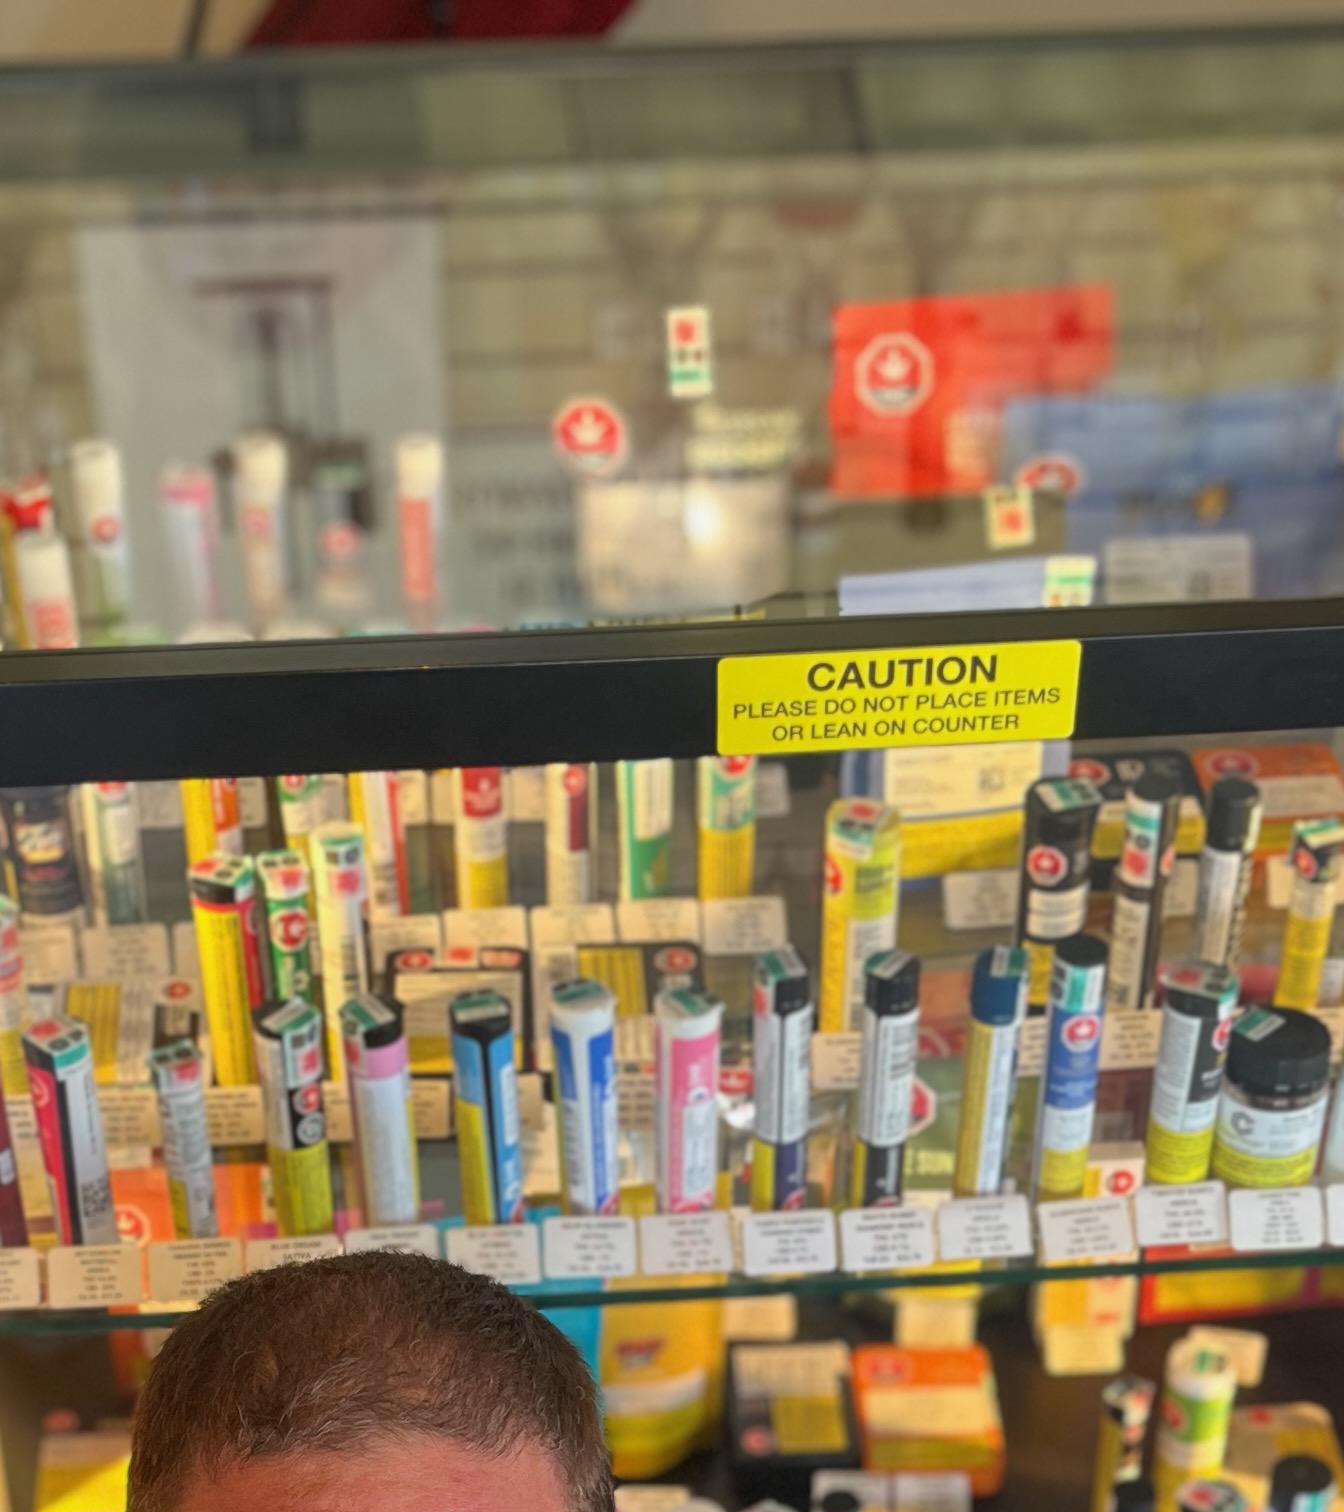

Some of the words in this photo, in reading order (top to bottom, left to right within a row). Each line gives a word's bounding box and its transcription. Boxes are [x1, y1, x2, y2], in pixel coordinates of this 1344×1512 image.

[806, 654, 998, 692] CAUTION
[732, 700, 817, 720] PLEASE
[824, 698, 857, 716] DO
[862, 695, 909, 714] NOT
[915, 690, 987, 711] PLACE
[993, 687, 1061, 707] ITEMS
[771, 724, 803, 742] OR
[810, 721, 867, 740] LEAN
[873, 719, 907, 736] ON
[912, 714, 1020, 735] COUNTER
[282, 1252, 312, 1261] SATIVA
